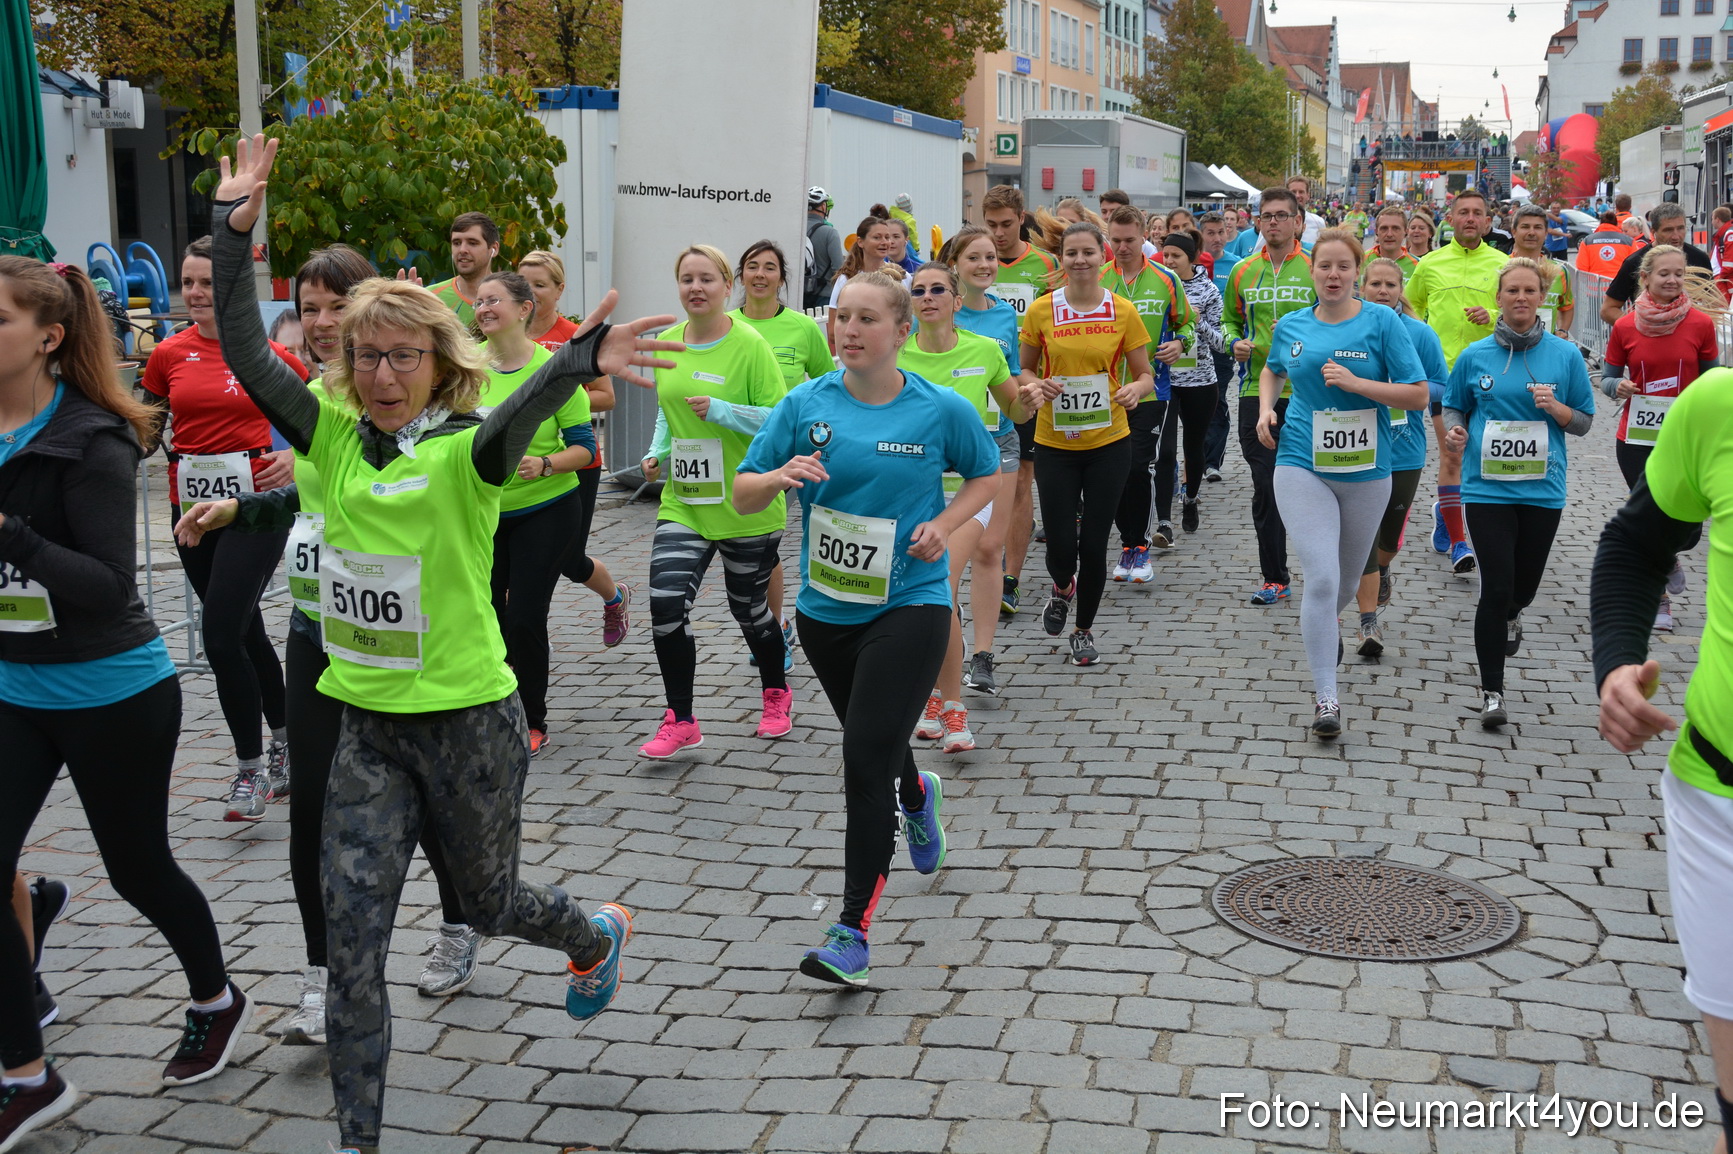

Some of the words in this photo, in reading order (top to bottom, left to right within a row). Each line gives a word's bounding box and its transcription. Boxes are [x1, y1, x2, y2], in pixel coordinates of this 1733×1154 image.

[91, 110, 103, 119] Hut
[105, 110, 111, 119] &
[113, 110, 131, 119] Mode
[1000, 136, 1015, 152] D
[1421, 162, 1441, 170] ZIEL
[618, 182, 772, 203] www.bmw-laufsport.de
[1243, 286, 1313, 304] BOCK
[1133, 299, 1165, 315] CK
[1053, 327, 1081, 339] MAX
[1085, 324, 1118, 335] BÖGL
[1334, 350, 1369, 360] BOCK
[1061, 391, 1102, 410] 5172
[1069, 414, 1096, 422] Elisabeth
[1636, 410, 1665, 427] 524
[1323, 428, 1368, 449] 5014
[877, 441, 926, 455] BOCK
[1490, 439, 1537, 458] 5204
[198, 461, 226, 469] BOCK
[1333, 454, 1360, 463] Stefanie
[675, 458, 710, 479] 5041
[1502, 463, 1525, 471] Regine
[186, 475, 241, 499] 5245
[682, 485, 699, 494] Maria
[838, 519, 868, 533] BOCK
[296, 542, 320, 573] 51
[818, 533, 879, 571] 5037
[349, 560, 385, 574] BOCK
[820, 568, 870, 589] Anna-Carina
[332, 580, 403, 624] 5106
[353, 630, 377, 647] Petra
